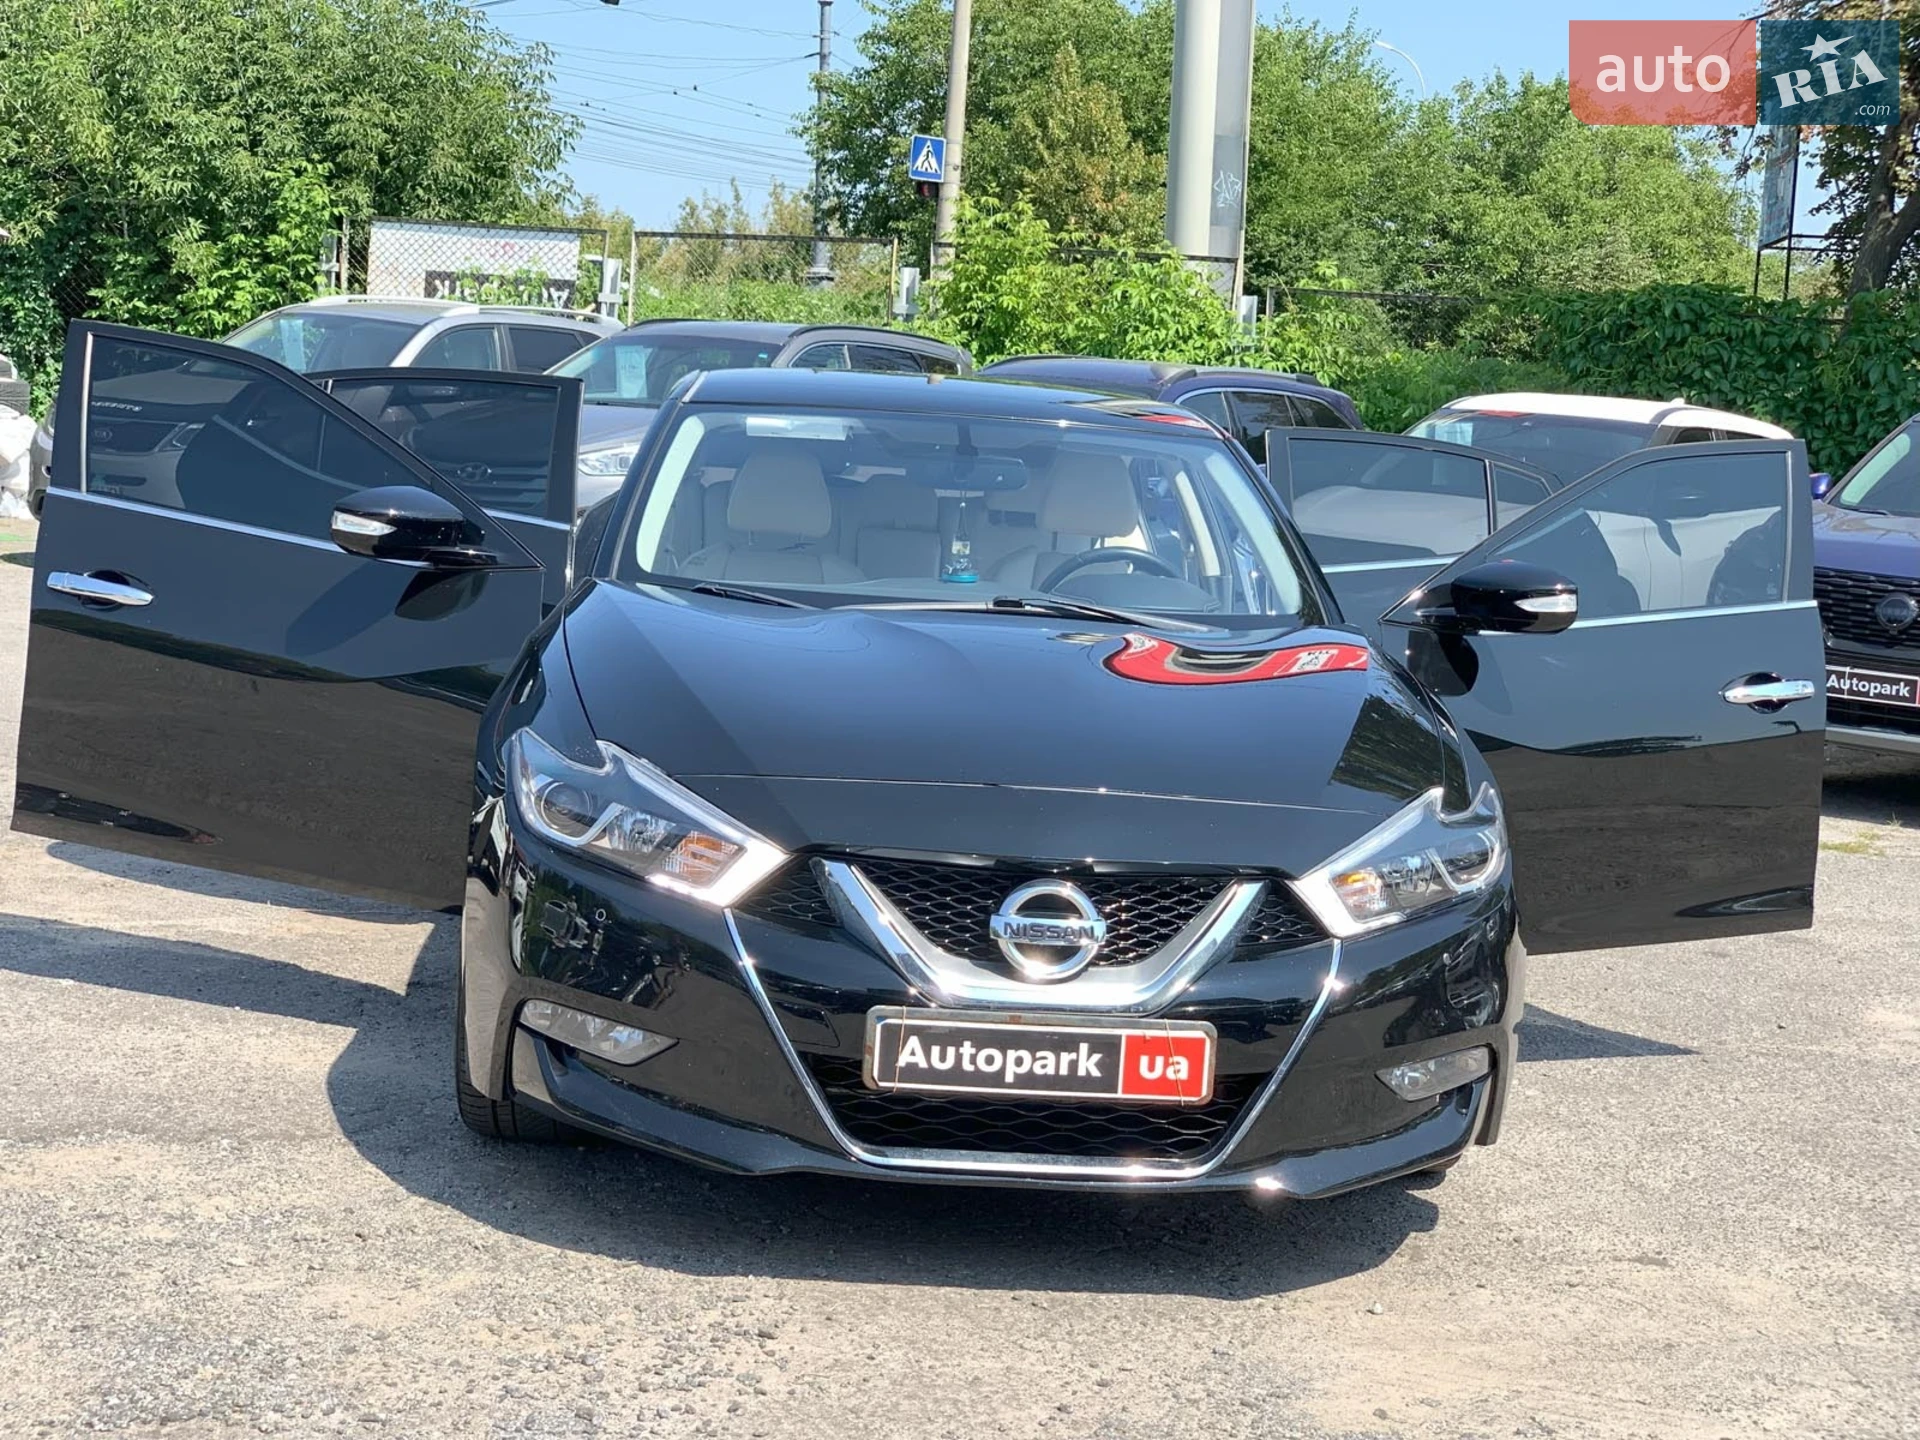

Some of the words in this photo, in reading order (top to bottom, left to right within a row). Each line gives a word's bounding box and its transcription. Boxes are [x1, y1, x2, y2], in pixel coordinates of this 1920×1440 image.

[1826, 674, 1910, 697] Autopark
[1003, 921, 1095, 941] NISSAN
[897, 1035, 1103, 1083] Autopark
[1138, 1054, 1190, 1080] ua
